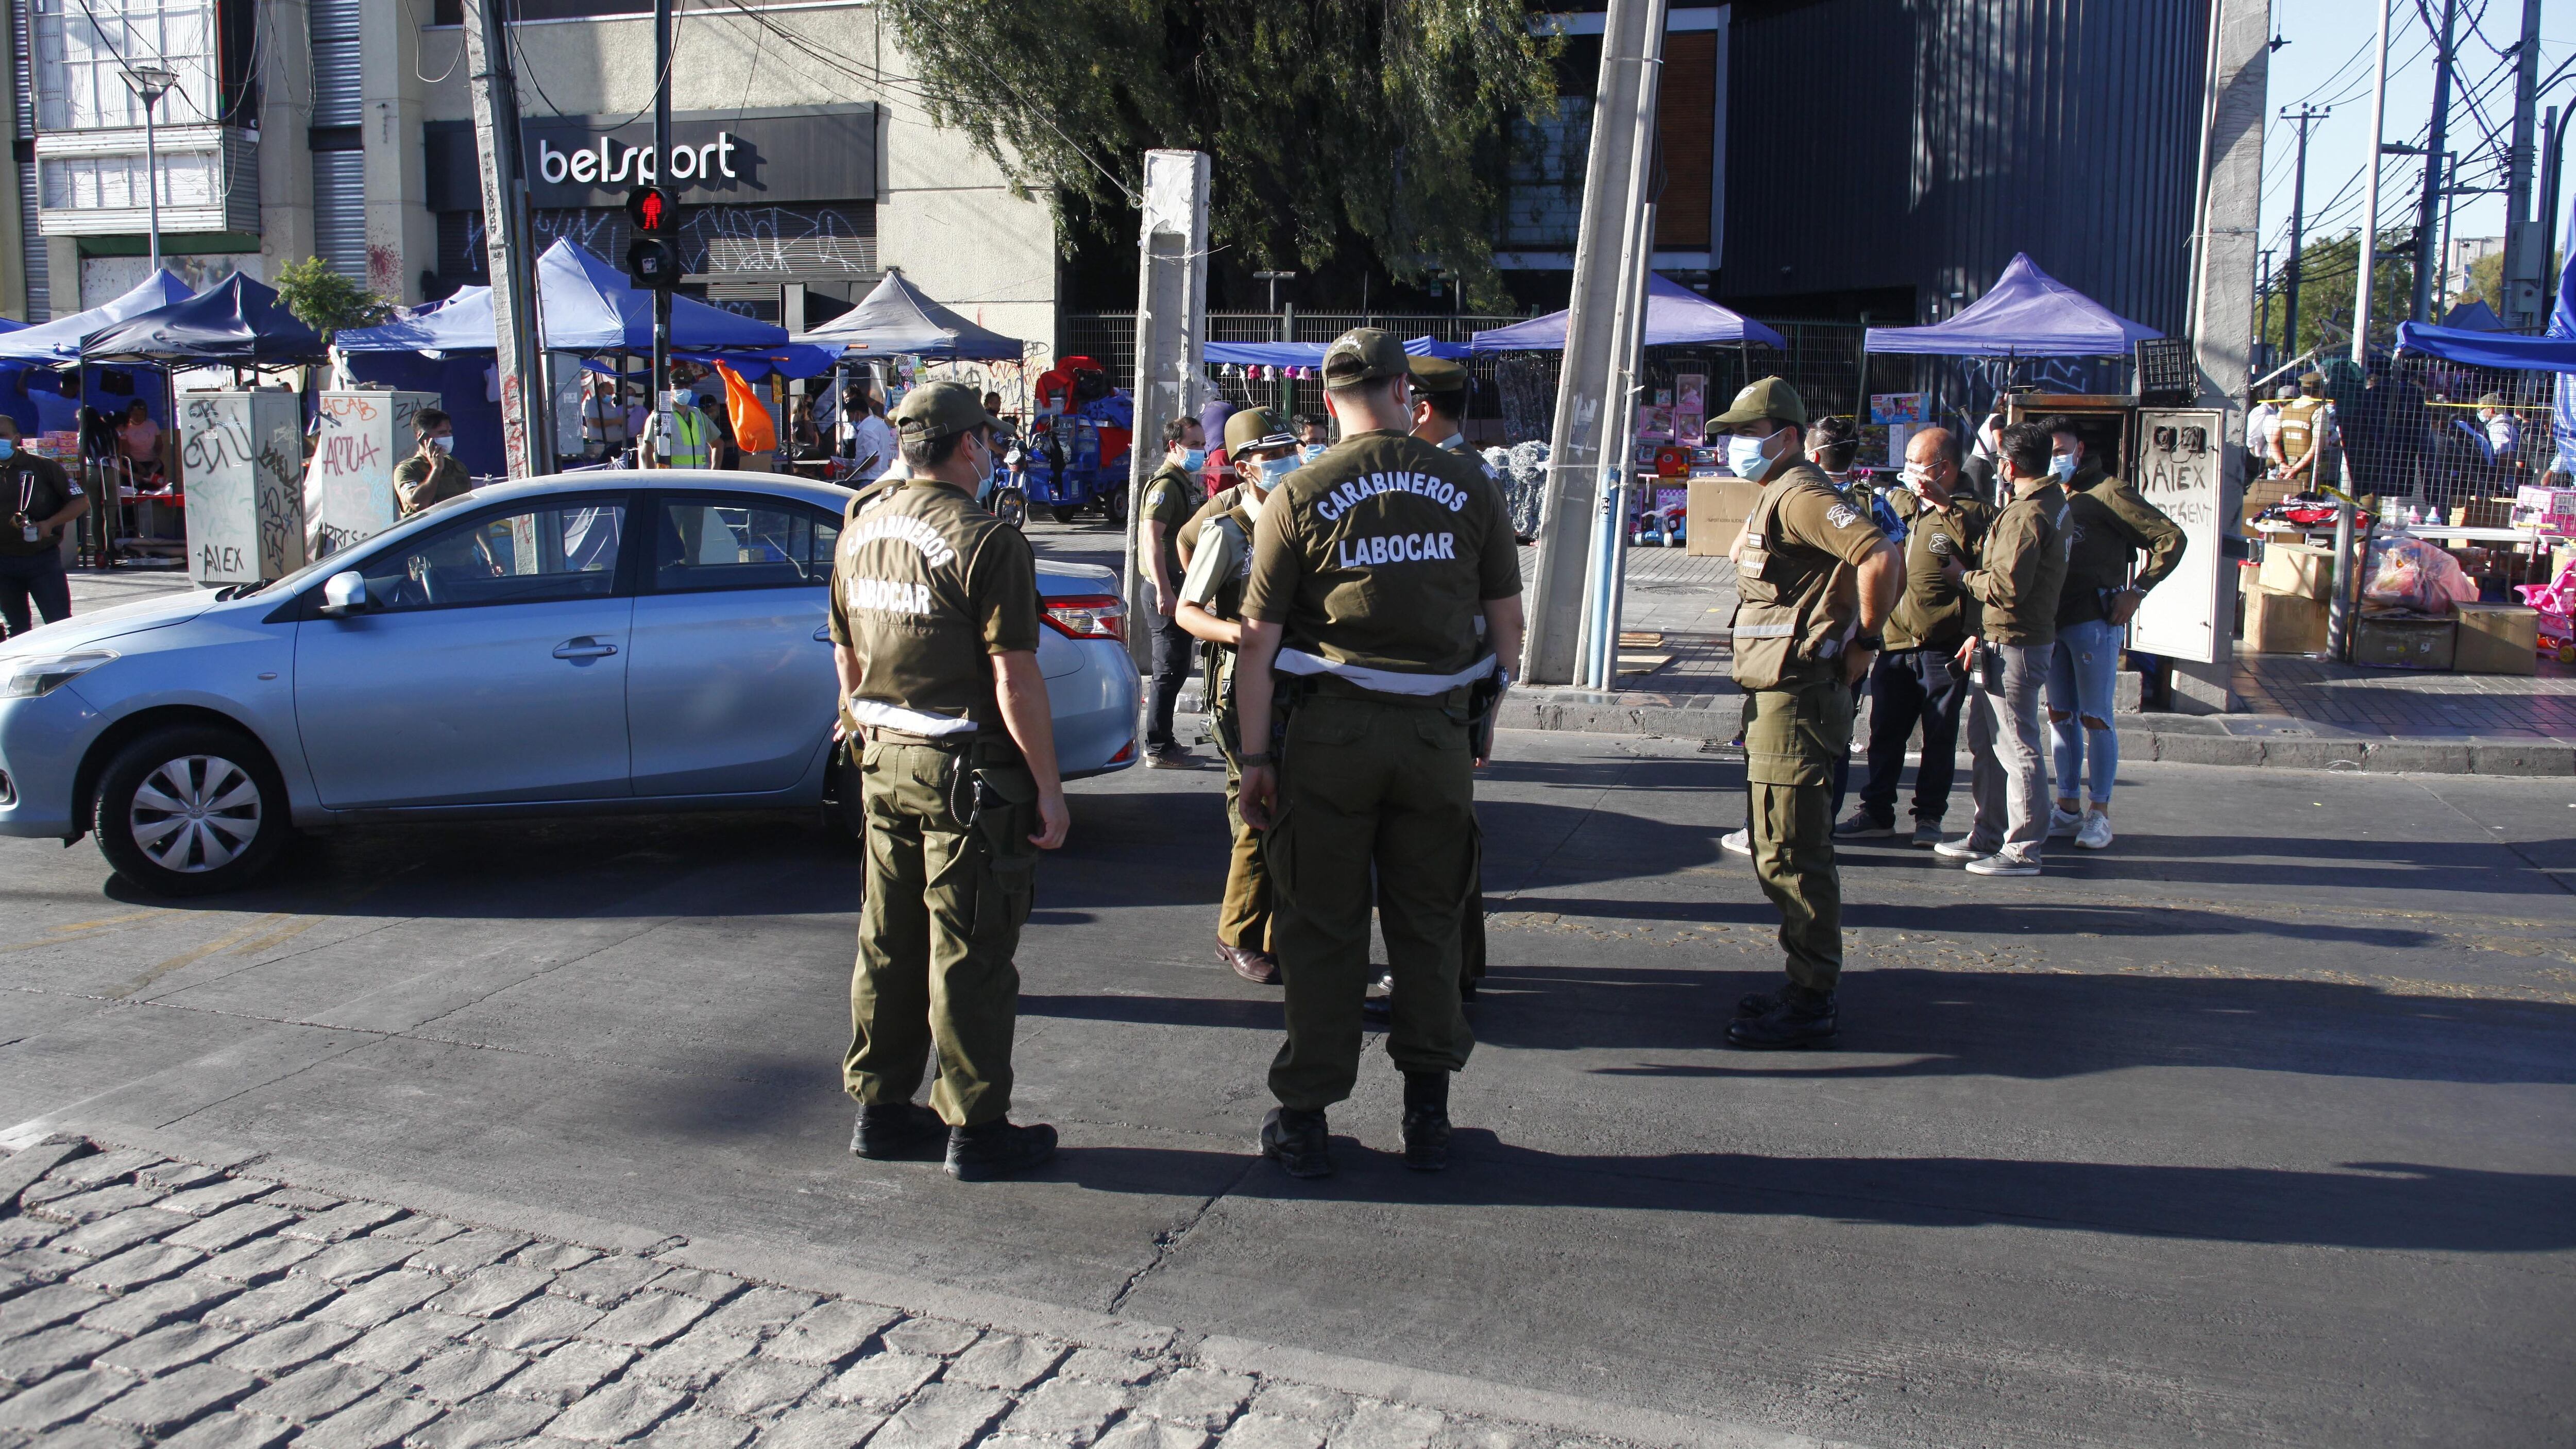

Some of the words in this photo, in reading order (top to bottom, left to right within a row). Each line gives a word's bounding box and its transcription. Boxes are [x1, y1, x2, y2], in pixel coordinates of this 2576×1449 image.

[540, 132, 735, 185] belsport
[323, 397, 377, 421] ACAB
[1317, 471, 1468, 521] CARABINEROS
[846, 515, 954, 567] CARABINEROS
[1340, 532, 1455, 569] LABOCAR
[848, 577, 930, 615] LABOCAR
